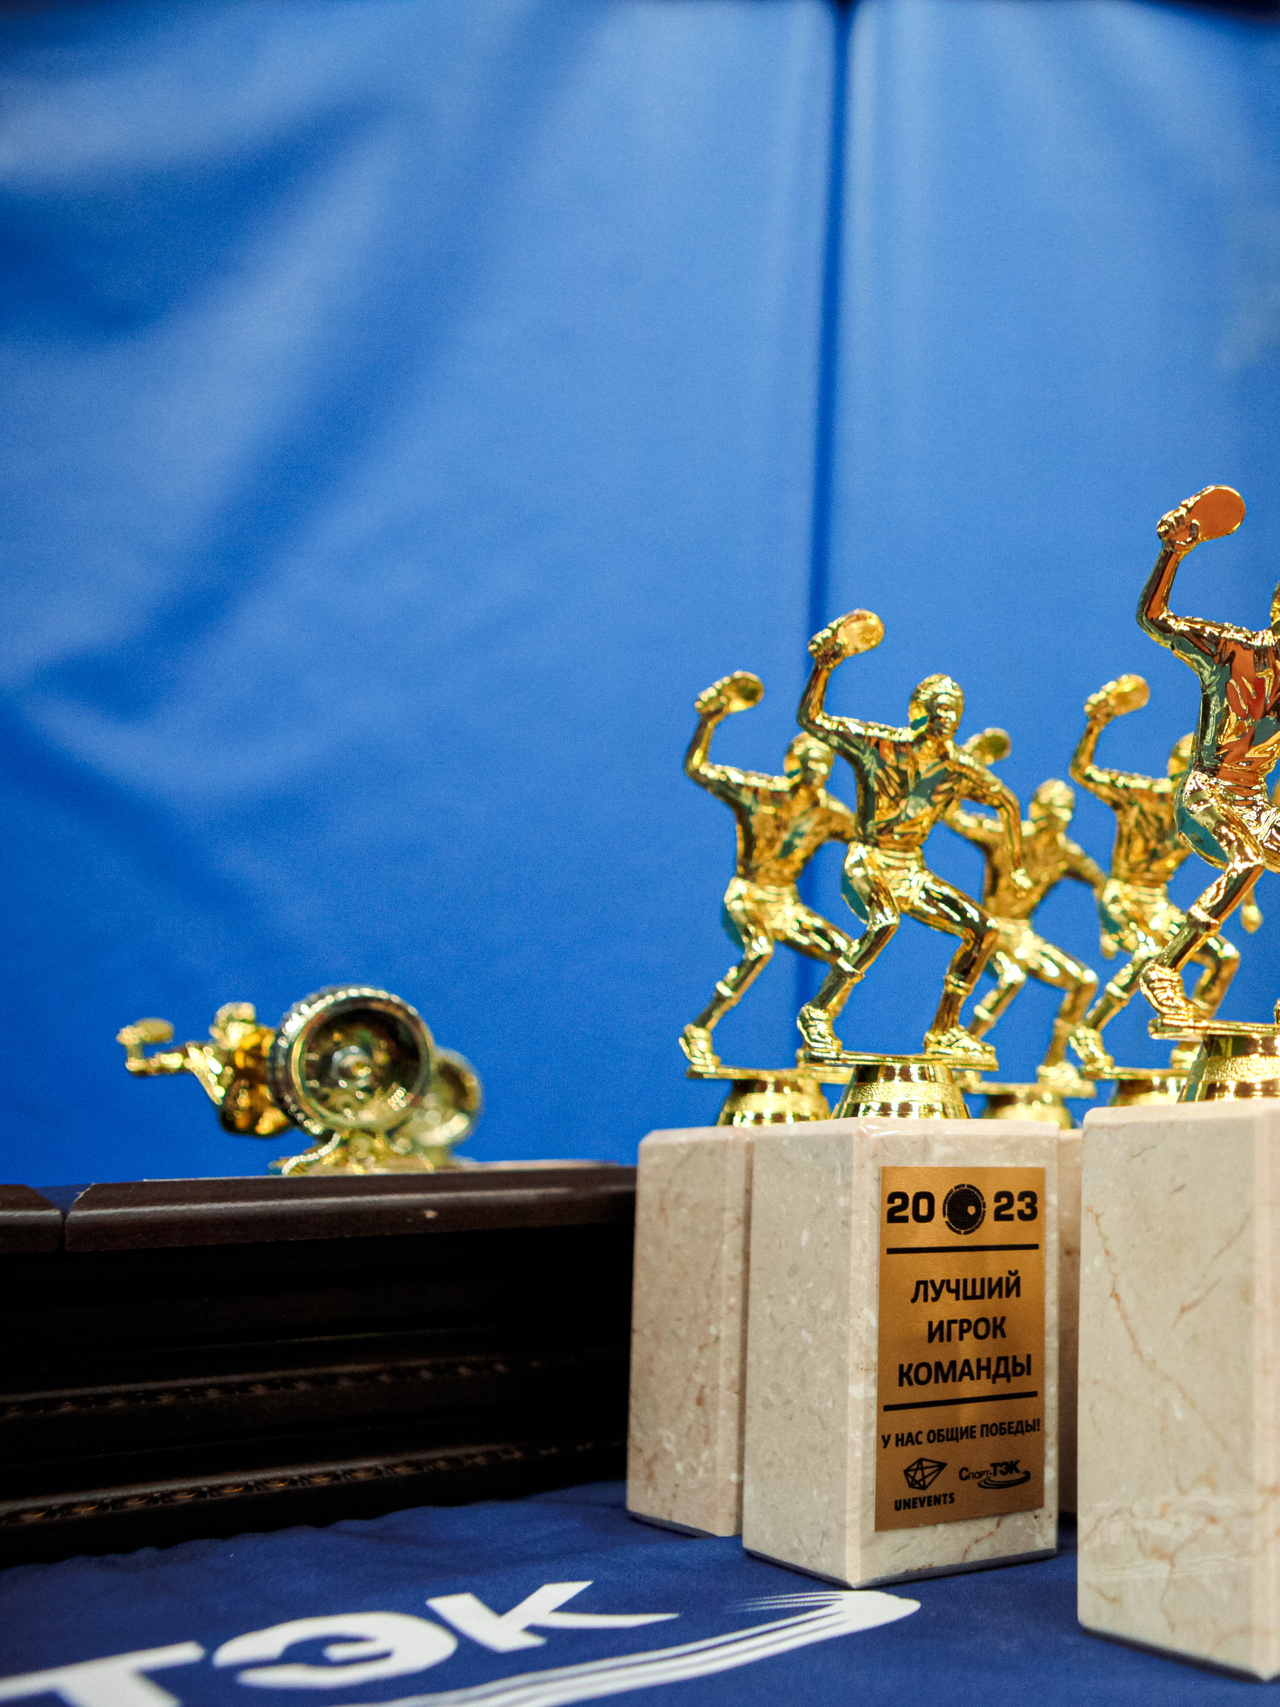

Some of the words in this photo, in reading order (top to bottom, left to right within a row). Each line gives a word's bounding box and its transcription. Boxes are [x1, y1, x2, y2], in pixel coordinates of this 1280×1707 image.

[886, 1191, 935, 1223] 20
[993, 1190, 1038, 1221] 23
[910, 1269, 1021, 1304] ЛУЧШИЙ
[927, 1316, 1006, 1343] ИГРОК
[898, 1353, 1031, 1387] КОМАНДЫ
[881, 1434, 891, 1449] У
[895, 1430, 923, 1447] НАС
[926, 1424, 977, 1443] ОБЩИЕ
[980, 1418, 1041, 1437] ПОБЕДЫ!
[894, 1492, 955, 1511] UNEVENTS
